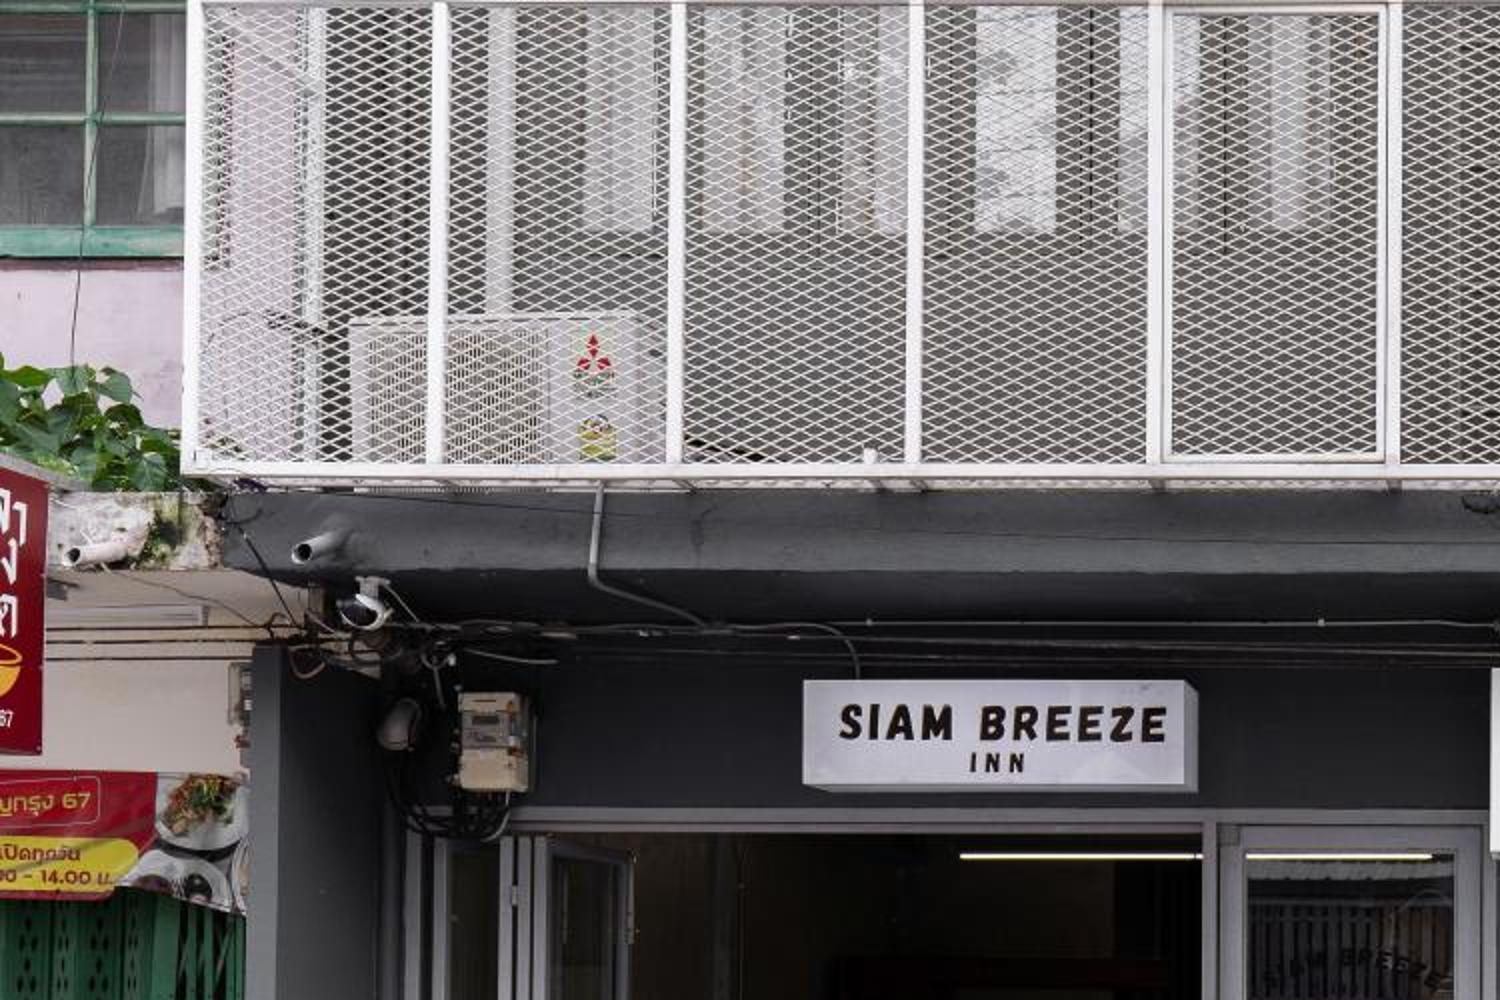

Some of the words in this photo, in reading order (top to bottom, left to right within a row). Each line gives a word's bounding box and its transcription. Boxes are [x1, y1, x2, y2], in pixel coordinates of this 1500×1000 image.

[838, 703, 953, 742] SIAM
[979, 704, 1168, 743] BREEZE
[969, 752, 1025, 773] INN
[62, 791, 91, 810] 67
